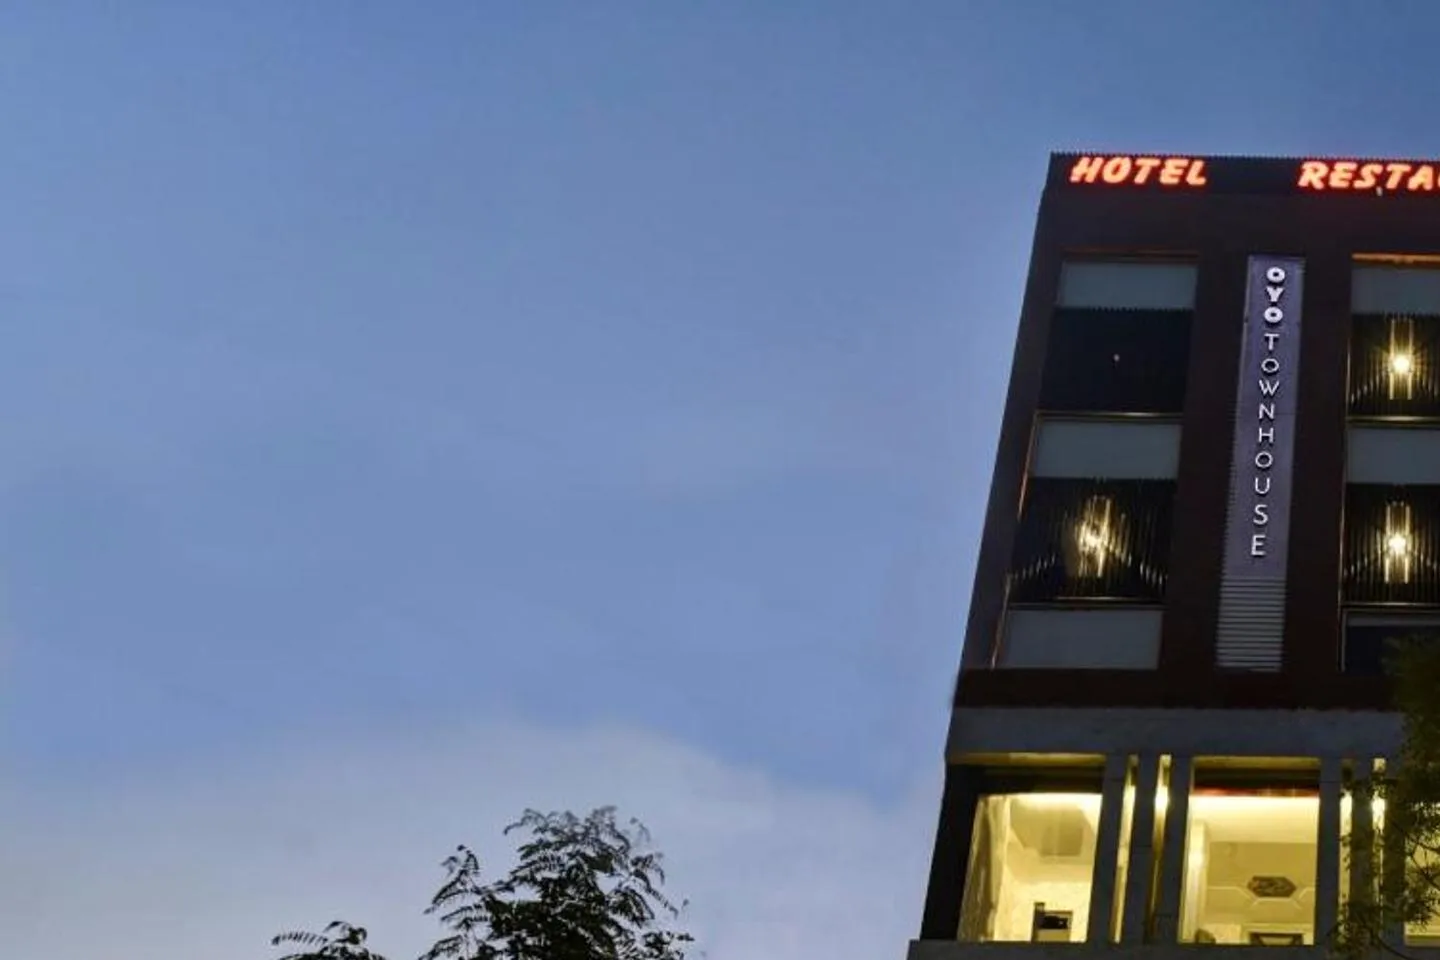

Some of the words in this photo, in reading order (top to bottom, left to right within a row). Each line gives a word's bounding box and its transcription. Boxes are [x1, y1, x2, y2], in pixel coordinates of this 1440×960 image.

[1069, 156, 1207, 185] HOTEL
[1264, 265, 1286, 323] OYO
[1250, 332, 1281, 556] TOWNHOUSE
